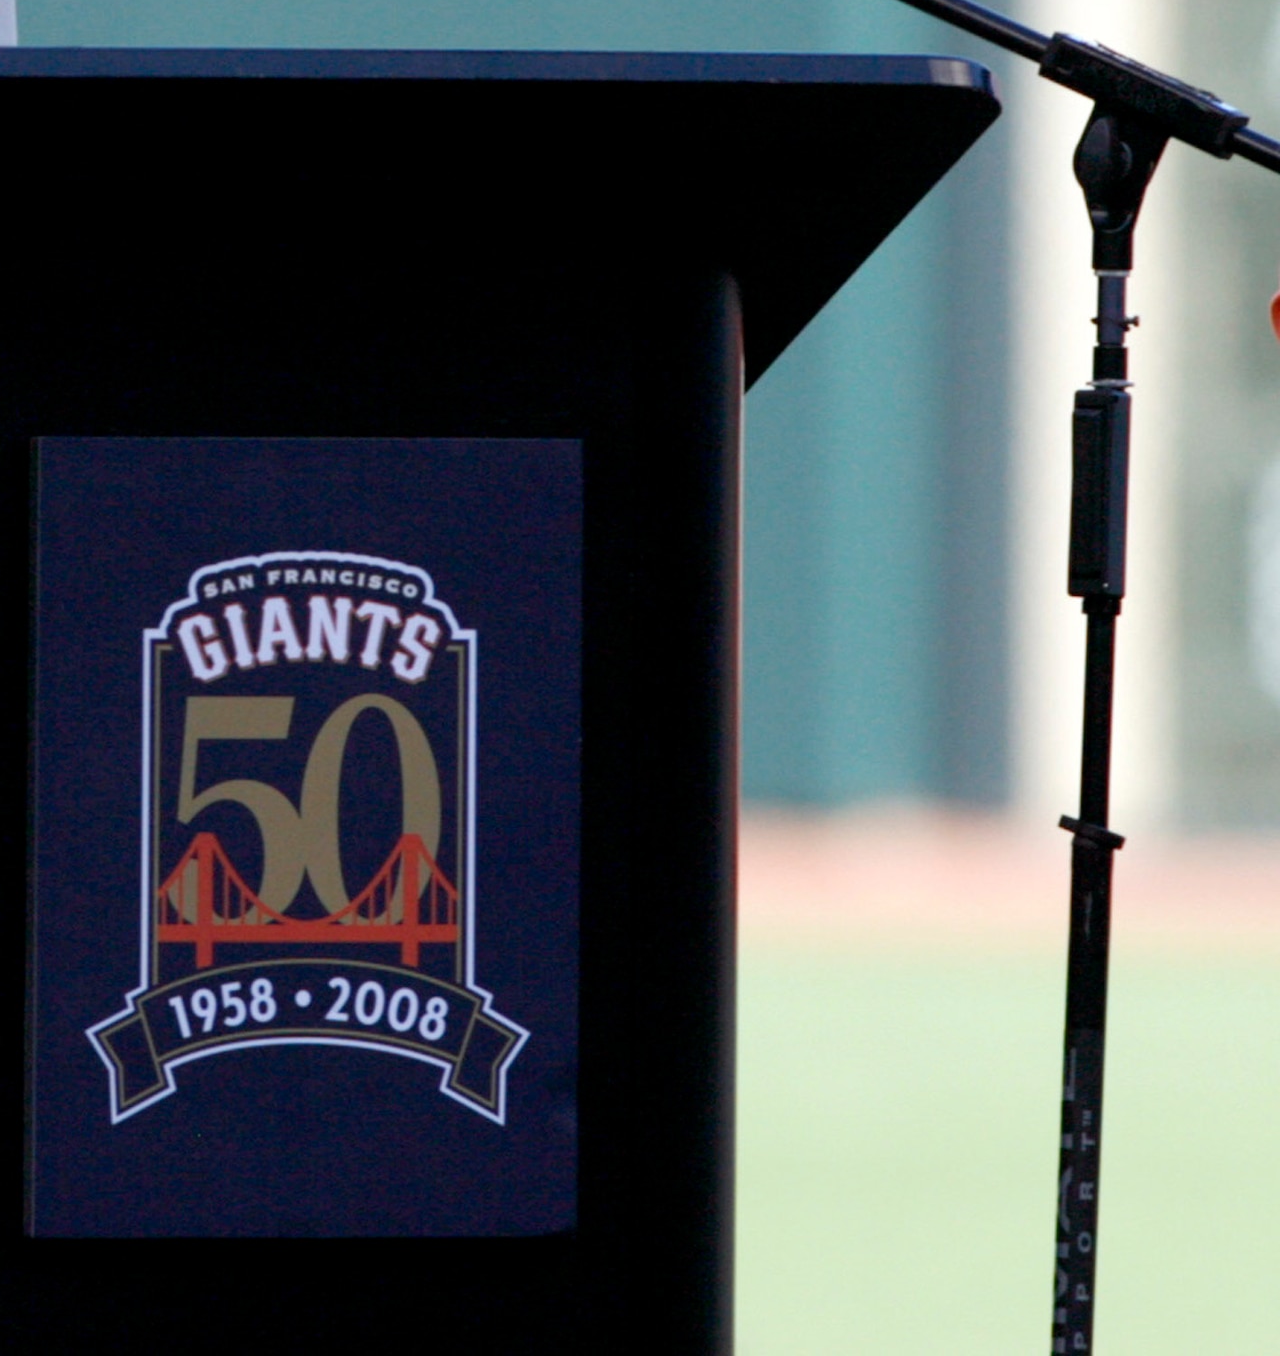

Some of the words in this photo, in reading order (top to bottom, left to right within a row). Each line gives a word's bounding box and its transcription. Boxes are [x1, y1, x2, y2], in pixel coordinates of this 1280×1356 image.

[204, 574, 255, 598] SAN
[266, 568, 419, 599] FRANCISCO
[177, 595, 441, 684] GIANTS
[168, 692, 441, 926] 50
[168, 977, 278, 1039] 1958
[324, 976, 449, 1041] 2008
